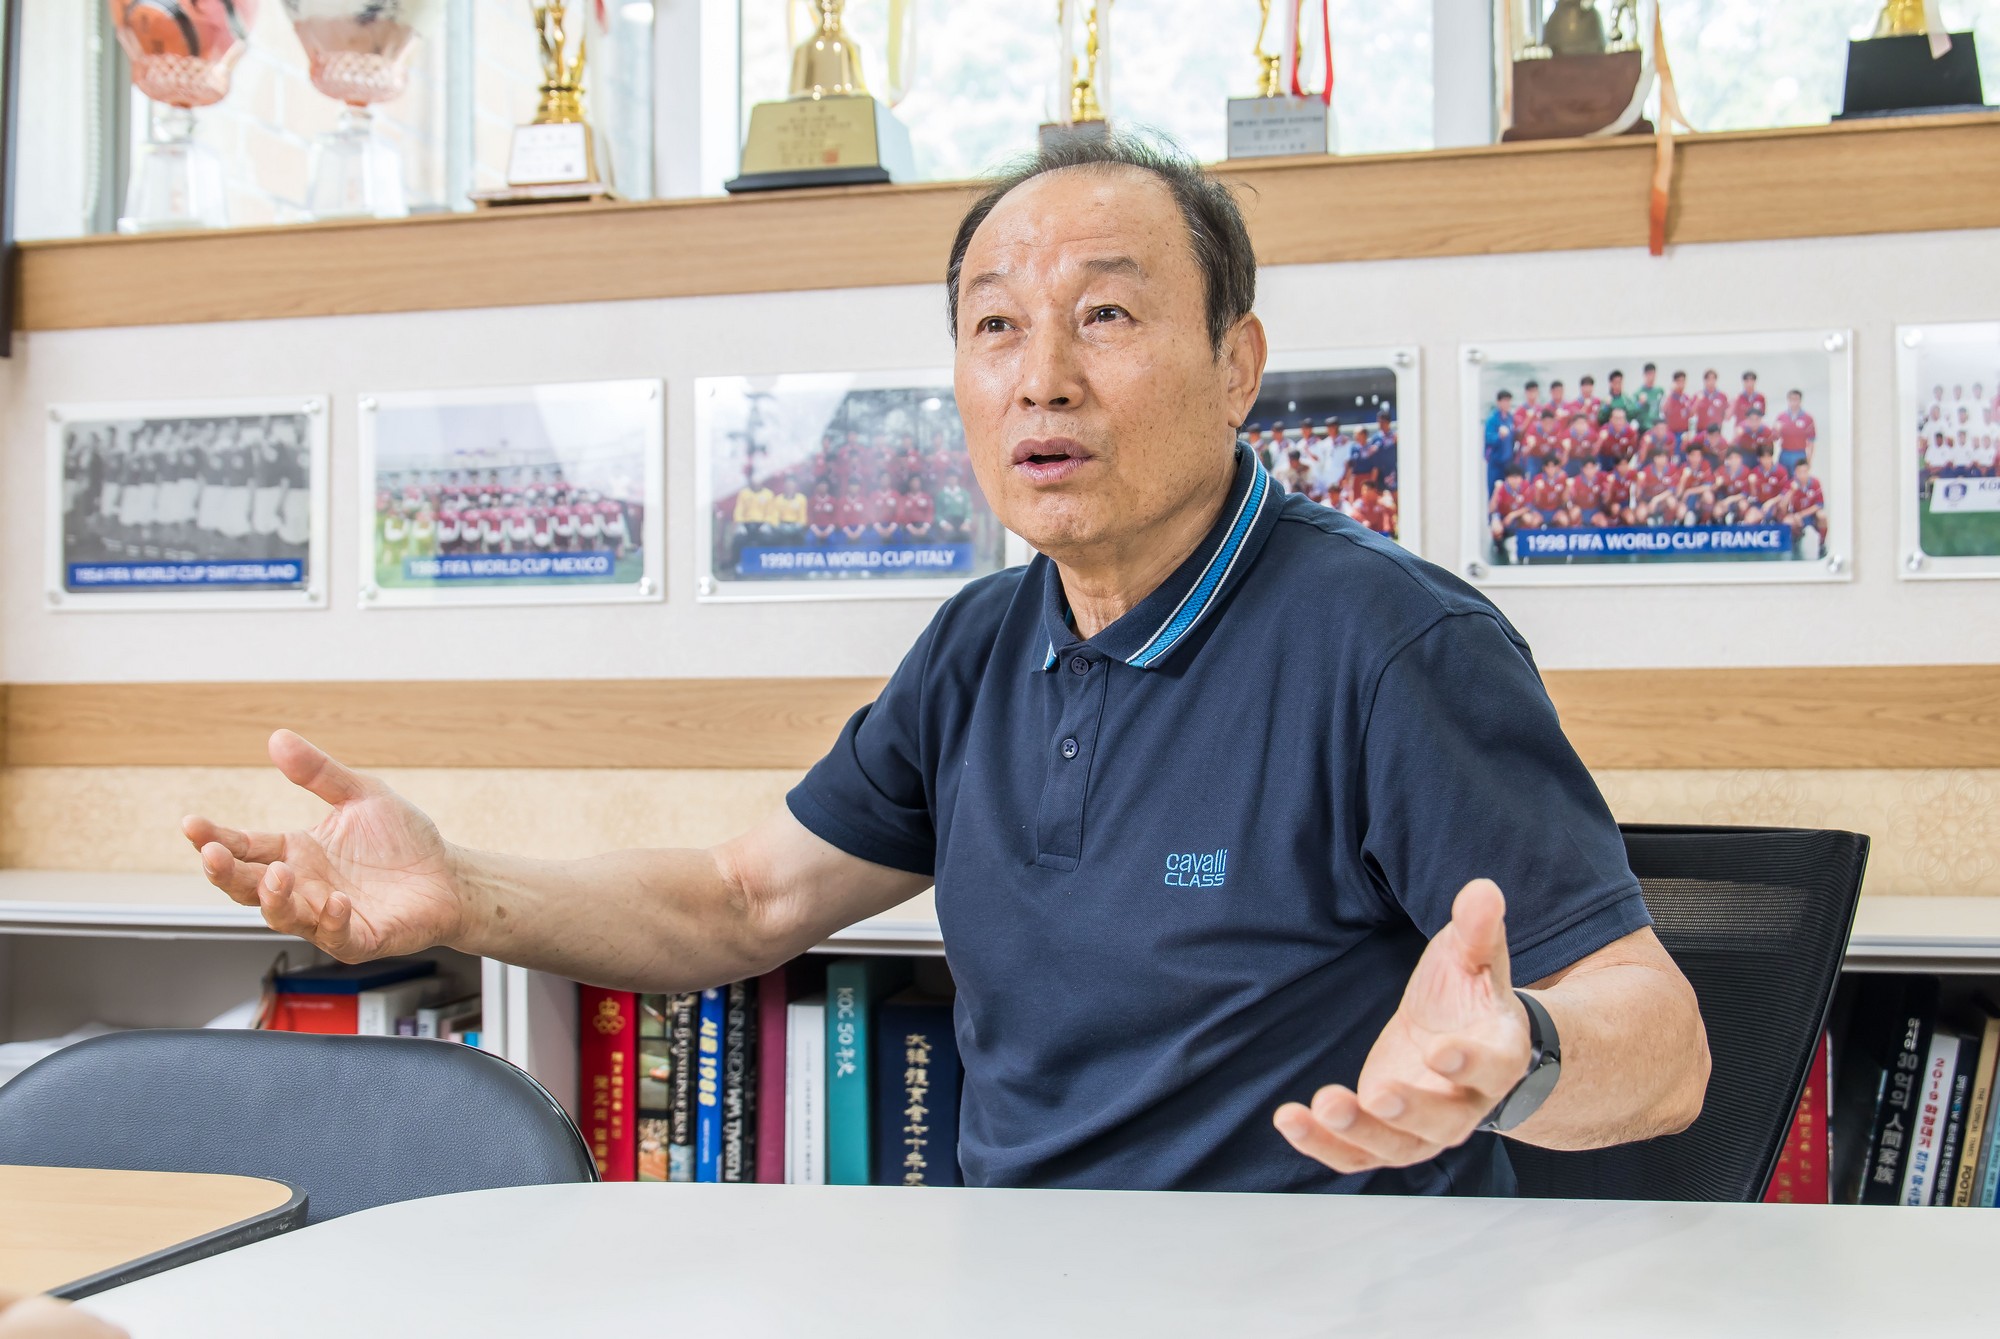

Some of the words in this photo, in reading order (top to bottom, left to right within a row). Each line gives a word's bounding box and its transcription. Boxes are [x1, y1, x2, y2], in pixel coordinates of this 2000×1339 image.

[1527, 534, 1568, 551] 1998
[1569, 533, 1603, 550] FIFA
[1607, 532, 1670, 549] WORLD
[1672, 531, 1709, 548] CUP
[1711, 530, 1781, 548] FRANCE
[442, 559, 470, 575] FIFA
[471, 558, 522, 574] WORLD
[522, 557, 551, 573] CUP
[551, 556, 610, 573] MEXICO
[795, 553, 825, 568] FIFA
[826, 552, 882, 568] WORLD
[882, 551, 915, 566] CUP
[915, 549, 956, 566] ITALY
[104, 566, 131, 582] FIFA
[132, 565, 176, 582] WORLD
[176, 565, 205, 581] CUP
[206, 563, 298, 580] SWITZERLAND
[1166, 849, 1228, 873] cavalli
[1164, 872, 1226, 888] CLASS
[837, 987, 855, 1020] KOC
[1904, 1018, 1921, 1051] 아시아
[698, 1057, 718, 1107] 1988
[725, 1088, 743, 1118] WM
[1873, 1112, 1905, 1186] 人間家族
[1957, 1165, 1974, 1206] FOOTB
